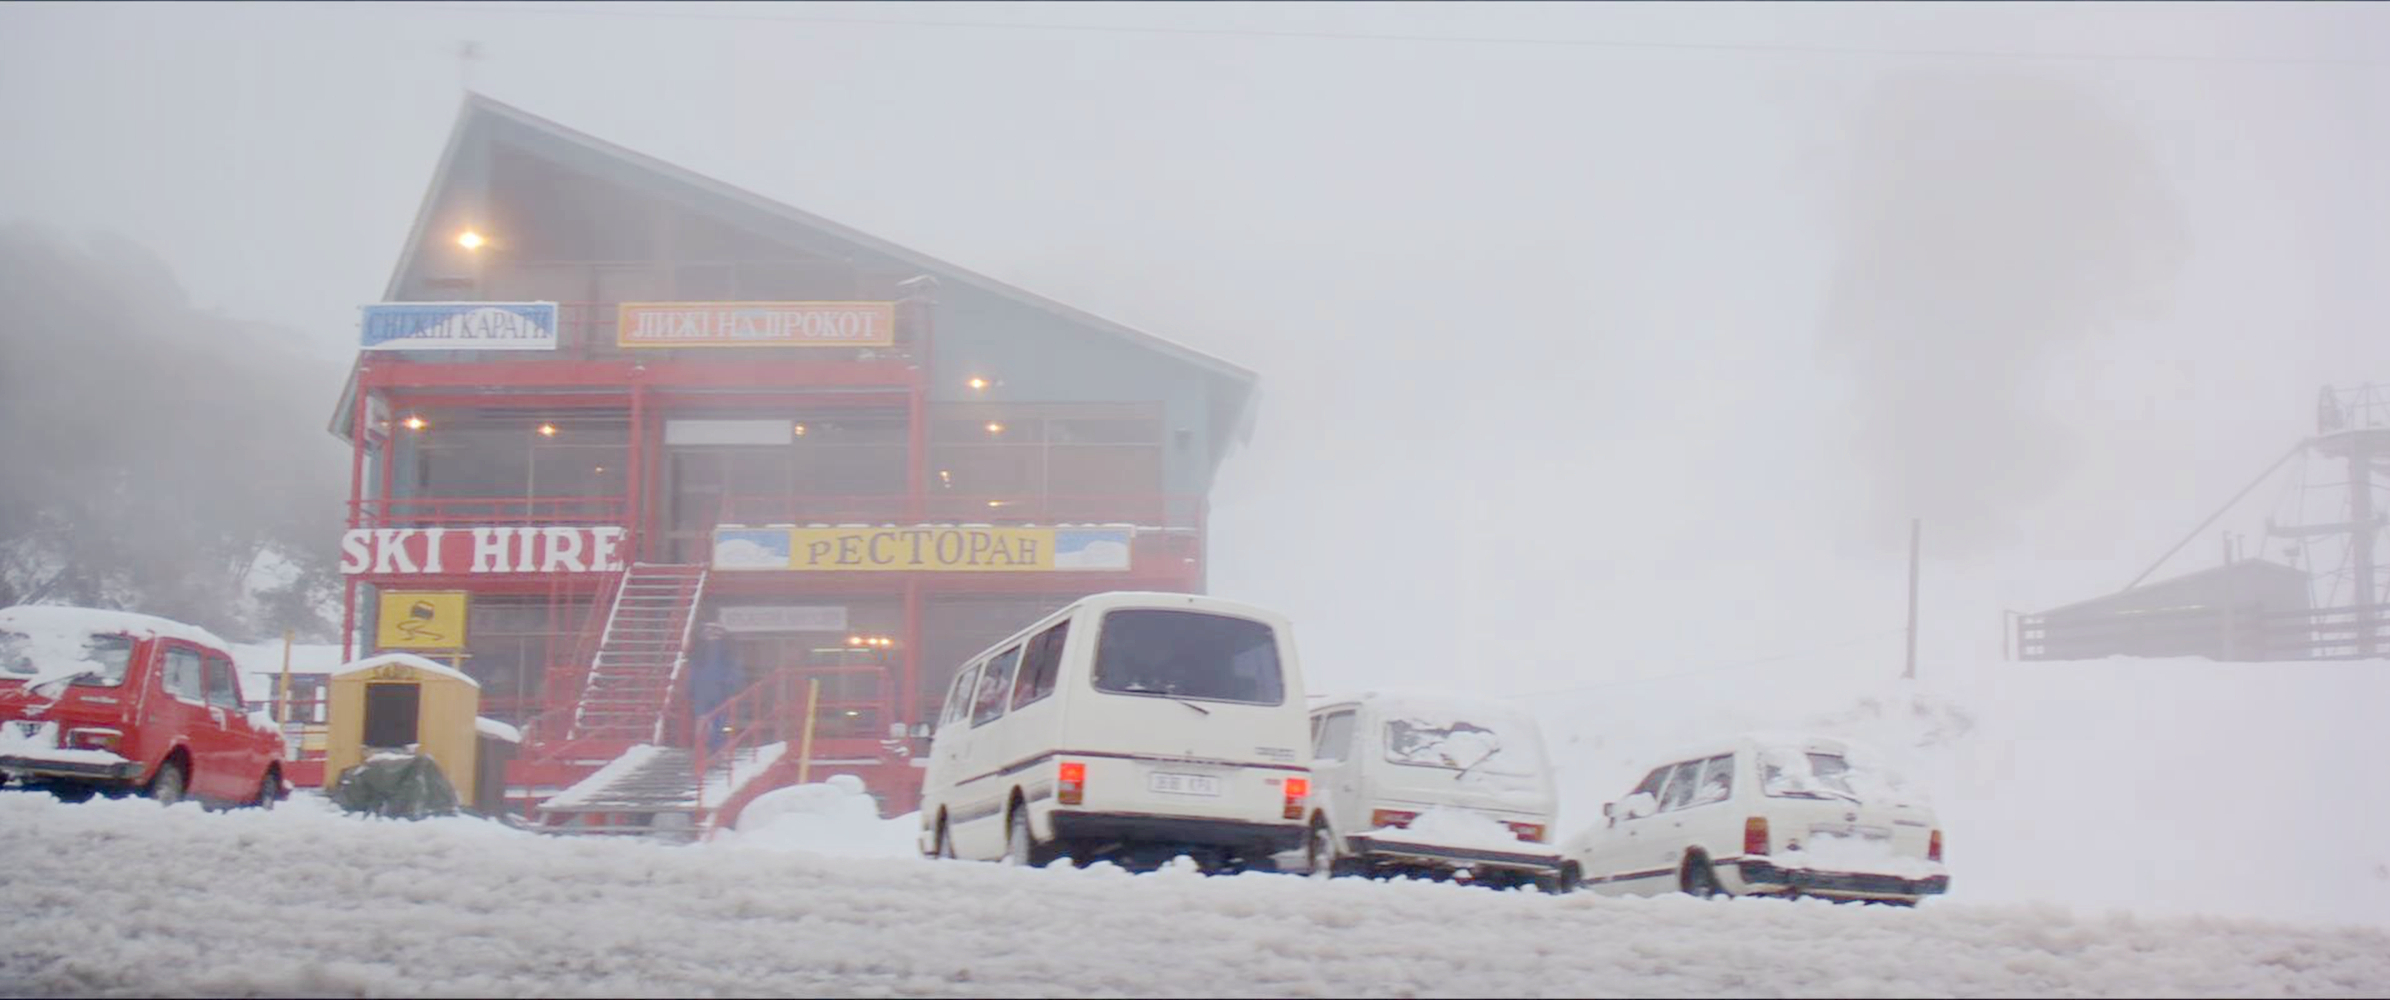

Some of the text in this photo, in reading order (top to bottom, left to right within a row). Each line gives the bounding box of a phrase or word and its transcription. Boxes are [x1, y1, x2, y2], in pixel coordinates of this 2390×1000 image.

[633, 310, 878, 338] ЛИЖІ НА ПРОКОТ
[340, 526, 626, 575] SKI HIRE
[807, 530, 1038, 566] РЕСТОРАН
